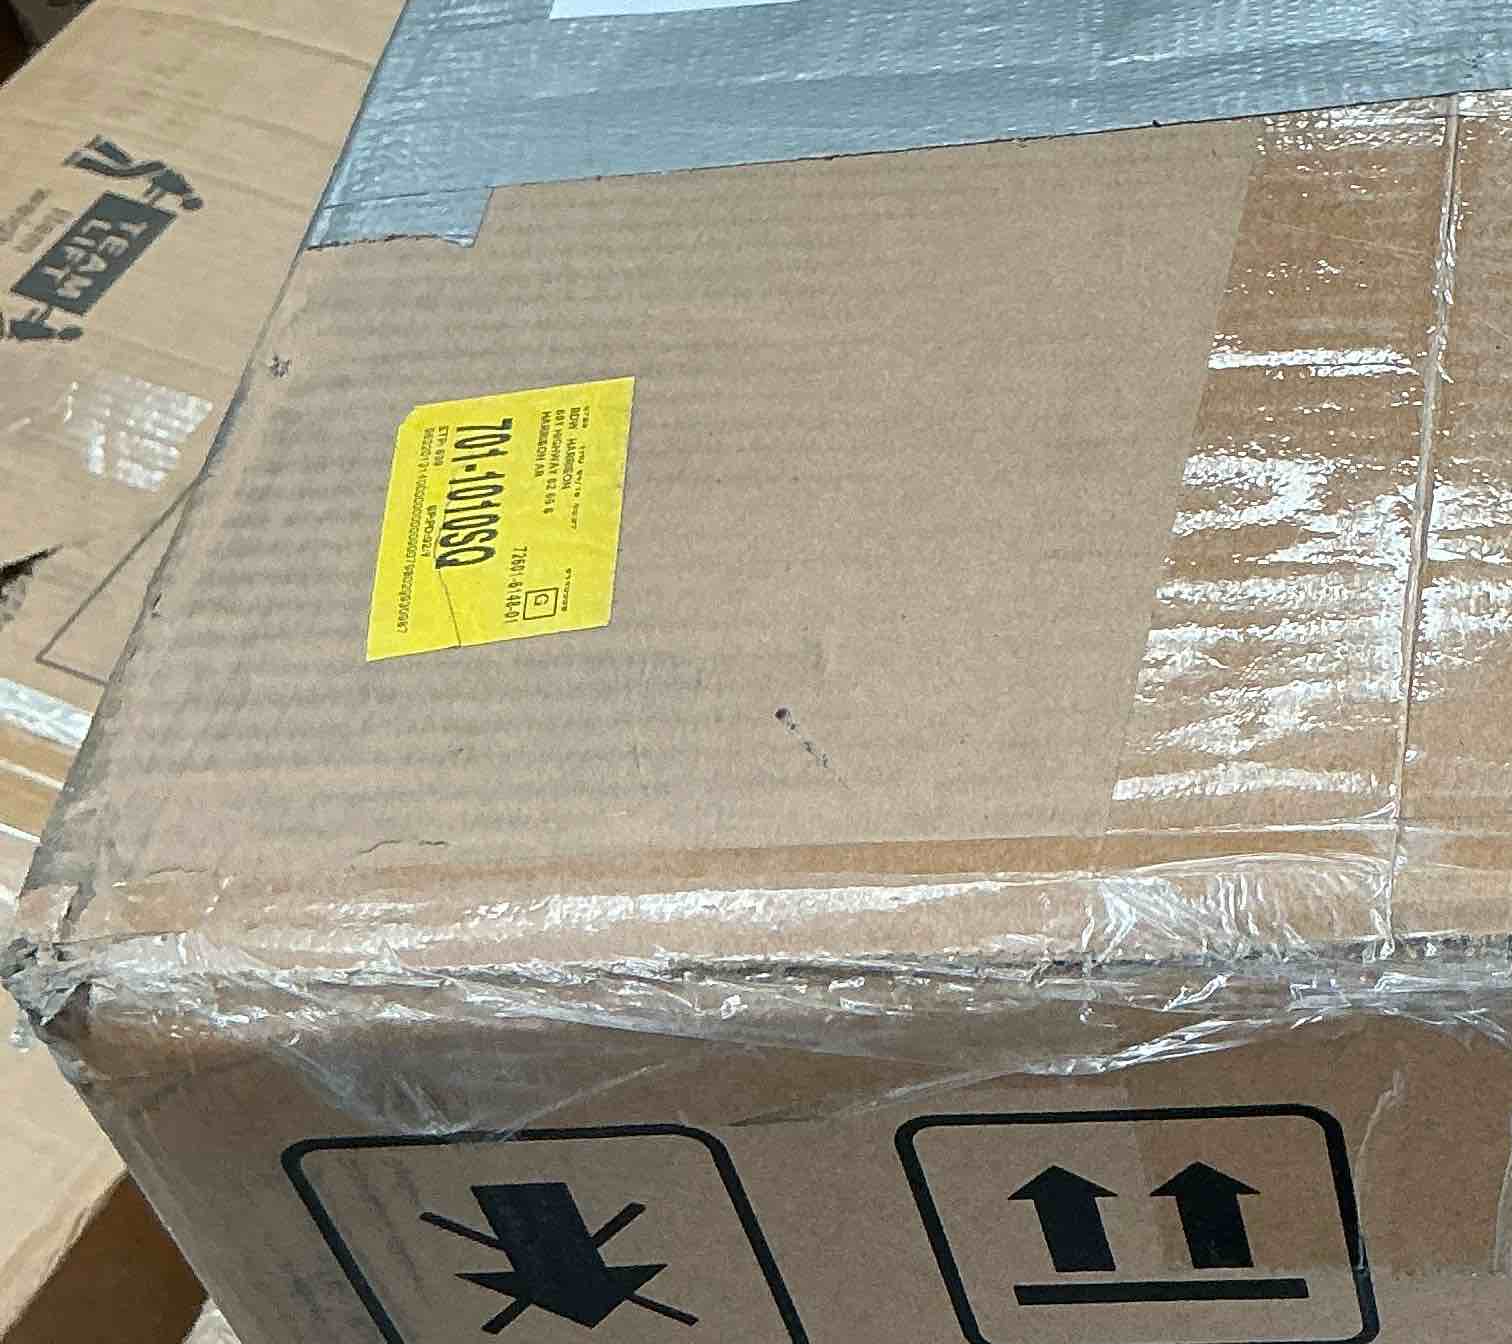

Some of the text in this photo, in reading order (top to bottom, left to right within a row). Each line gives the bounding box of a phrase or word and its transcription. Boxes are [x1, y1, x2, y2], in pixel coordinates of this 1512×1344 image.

[43, 218, 113, 281] LIFT
[56, 220, 149, 299] TEAM
[435, 417, 514, 570] 701-1010SQ
